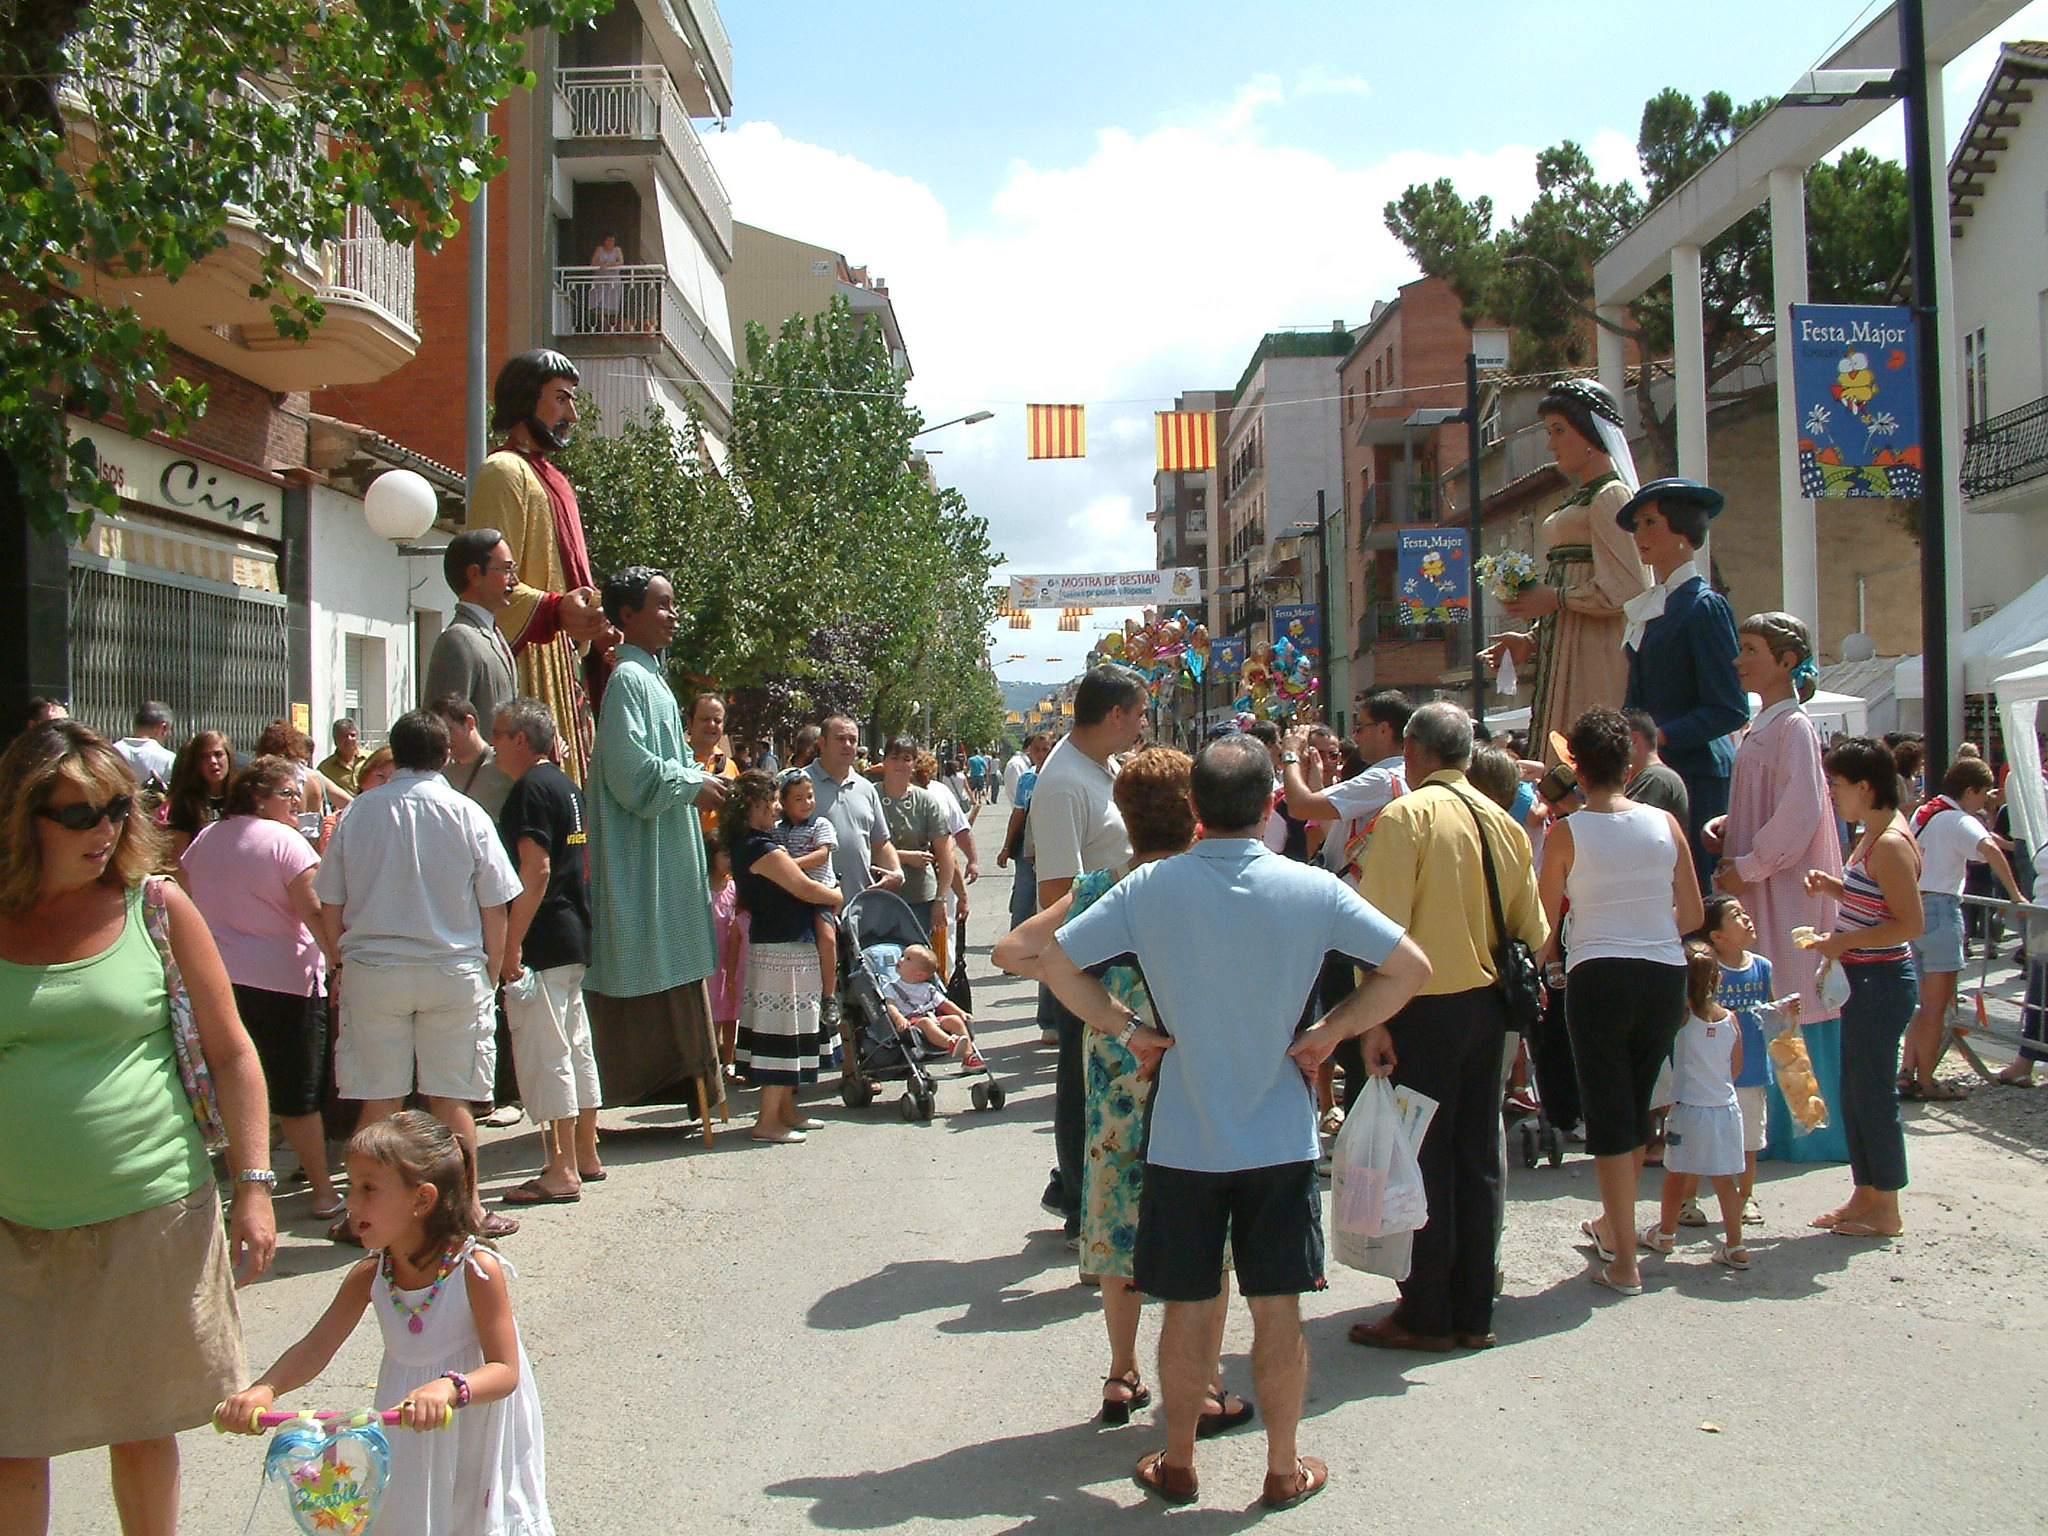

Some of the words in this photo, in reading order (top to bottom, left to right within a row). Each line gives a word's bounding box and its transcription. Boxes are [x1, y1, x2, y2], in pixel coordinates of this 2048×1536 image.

[1801, 319, 1845, 342] Festa
[1851, 321, 1906, 349] Major
[99, 455, 124, 488] lsos
[1402, 536, 1429, 549] Festa
[1431, 536, 1464, 550] Major
[1061, 576, 1102, 588] MOSTRA
[1104, 575, 1117, 587] DE
[1119, 573, 1161, 586] BESTIARI
[1275, 608, 1293, 618] Festa
